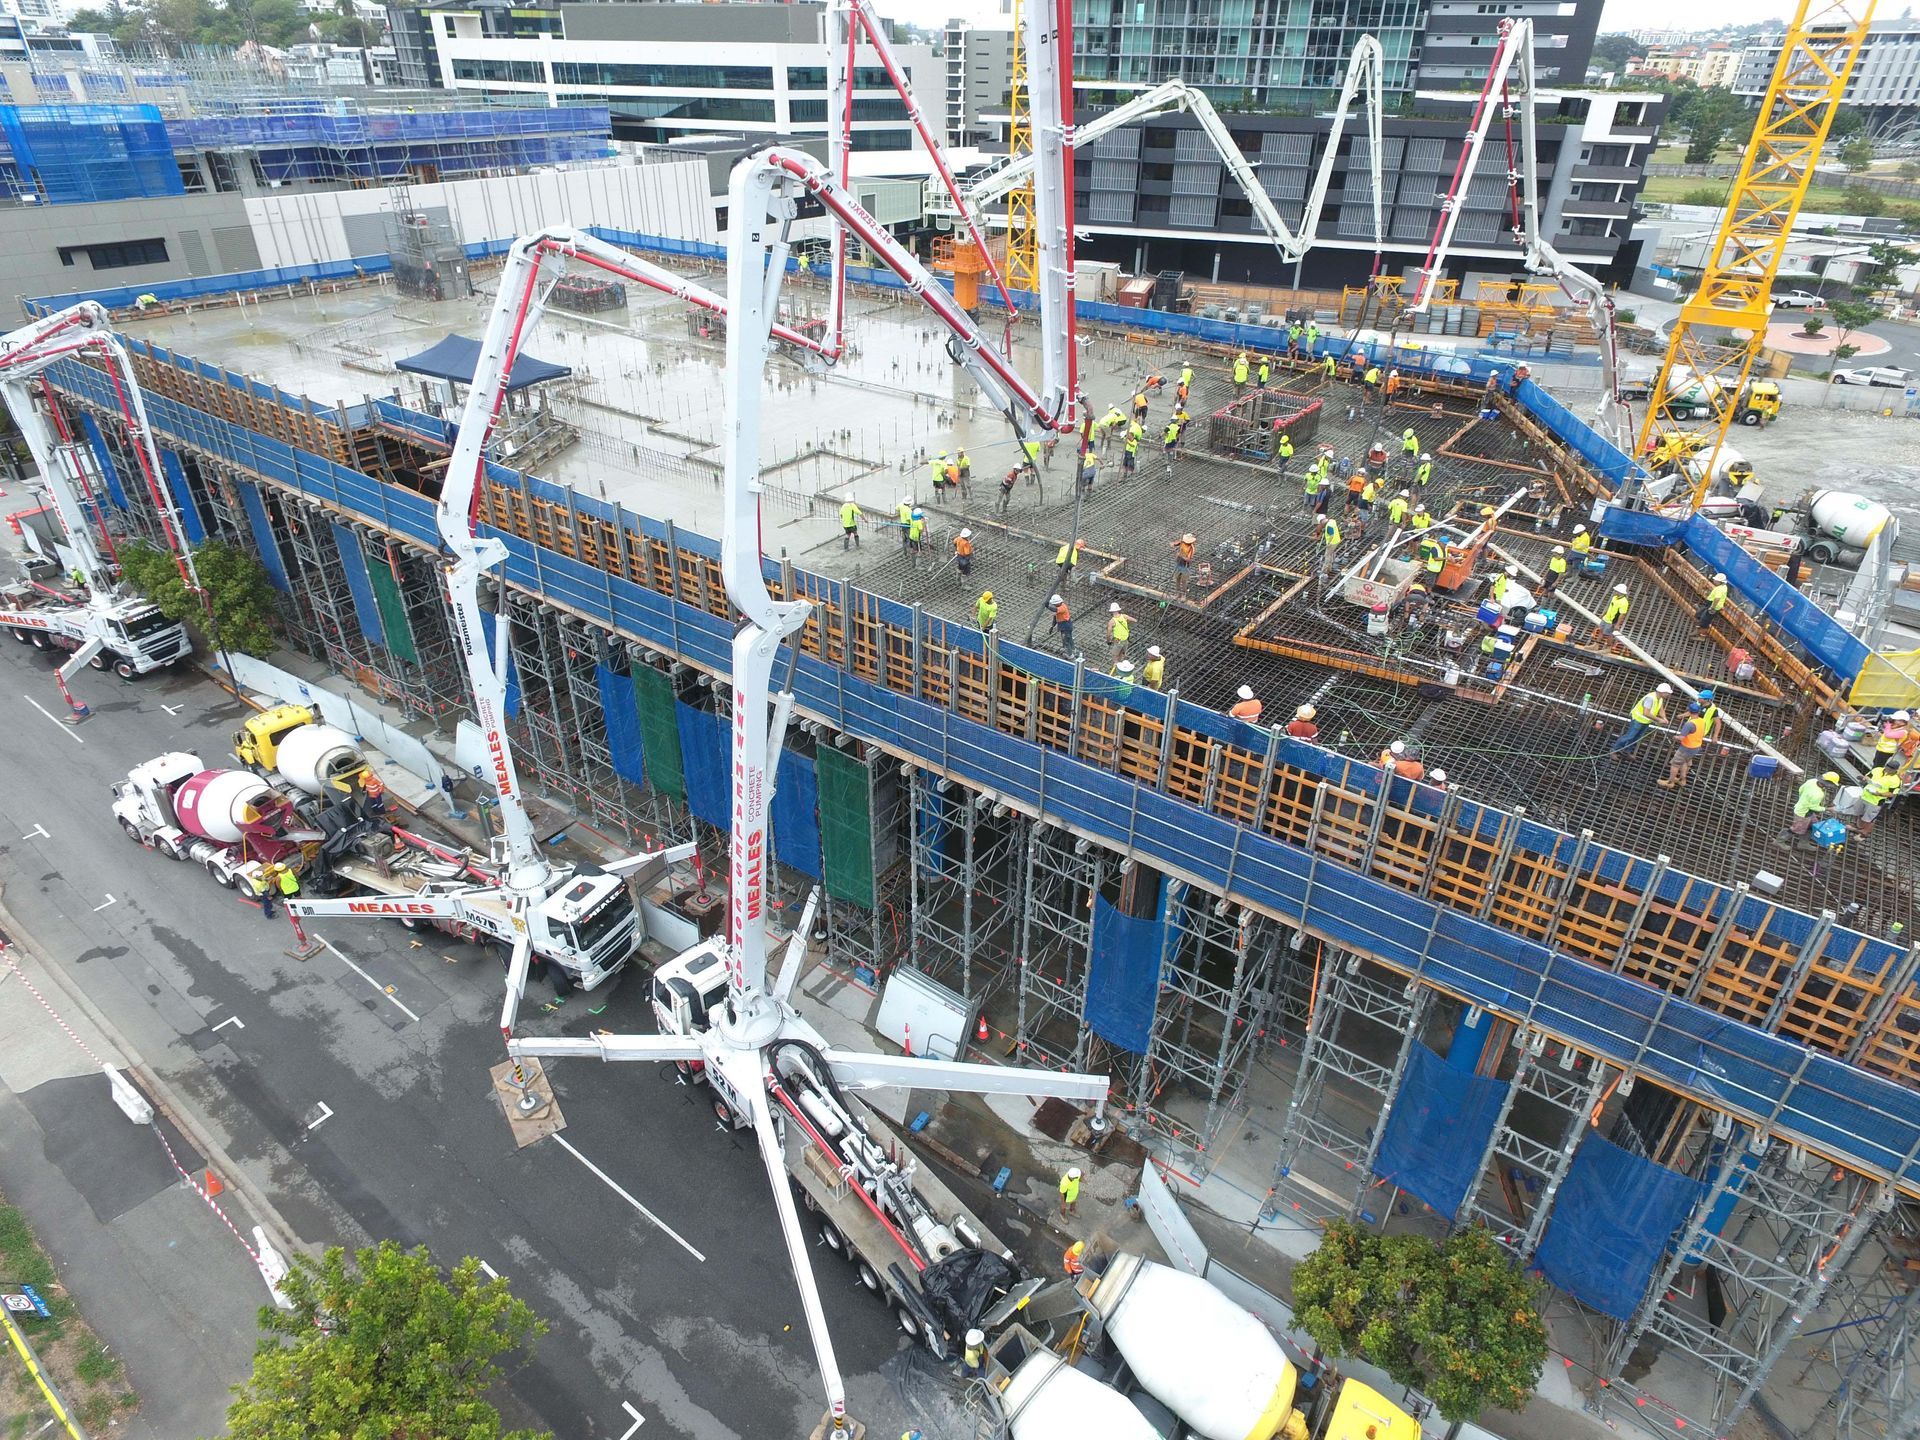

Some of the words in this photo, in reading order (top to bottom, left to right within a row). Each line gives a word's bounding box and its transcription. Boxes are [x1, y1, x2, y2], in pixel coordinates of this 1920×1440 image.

[1684, 385, 1702, 400] RAL
[0, 615, 48, 628] MEALES
[480, 698, 491, 732] CONCRETE
[485, 698, 496, 728] PUMPING
[488, 731, 512, 796] MEALES
[748, 765, 756, 822] CONCRETE
[756, 770, 764, 818] PUMPING
[748, 828, 762, 922] MEALES
[348, 902, 436, 914] MEALES
